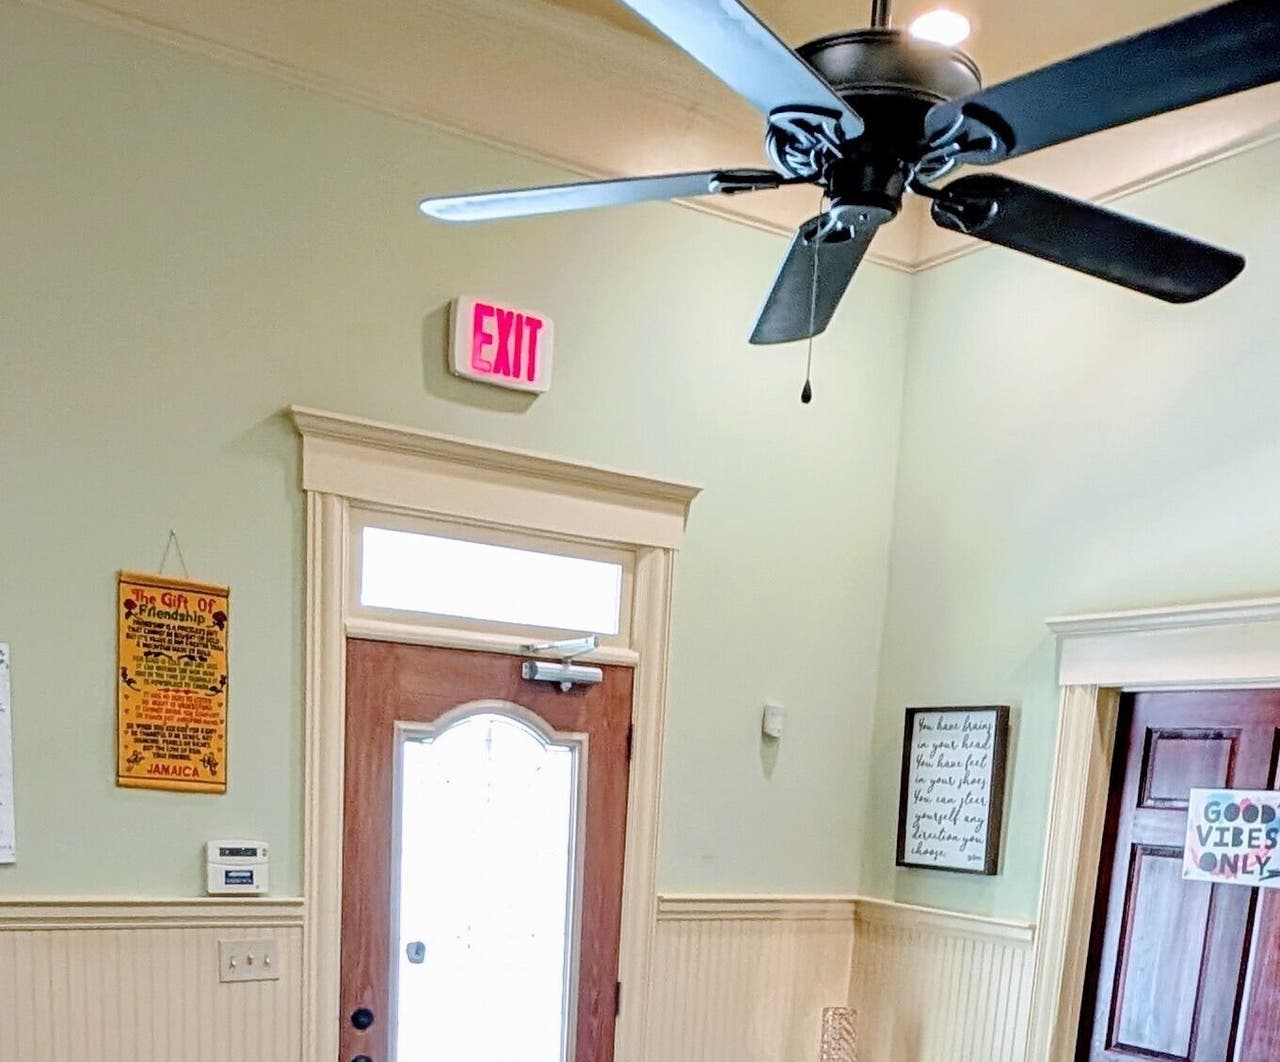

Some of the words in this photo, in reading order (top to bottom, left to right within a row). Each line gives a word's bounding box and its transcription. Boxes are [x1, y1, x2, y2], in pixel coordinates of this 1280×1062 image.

[472, 303, 543, 382] EXIT
[132, 589, 156, 604] The
[161, 593, 188, 609] Gift
[198, 598, 217, 613] Of
[139, 604, 206, 624] Friendship
[919, 718, 933, 731] You
[937, 715, 960, 731] have
[917, 741, 928, 749] in
[932, 741, 958, 758] your
[147, 764, 200, 778] JAMAICA
[916, 755, 932, 768] You
[937, 754, 962, 768] have
[964, 754, 987, 771] feet
[915, 776, 926, 785] in
[928, 776, 955, 793] your
[913, 789, 932, 803] You
[936, 796, 956, 804] can
[912, 807, 961, 828] yourself
[964, 814, 985, 833] any
[1203, 801, 1276, 824] GOOD
[911, 826, 961, 841] direction
[961, 835, 984, 851] you
[1196, 823, 1279, 849] VIBES
[1200, 852, 1271, 875] ONLY
